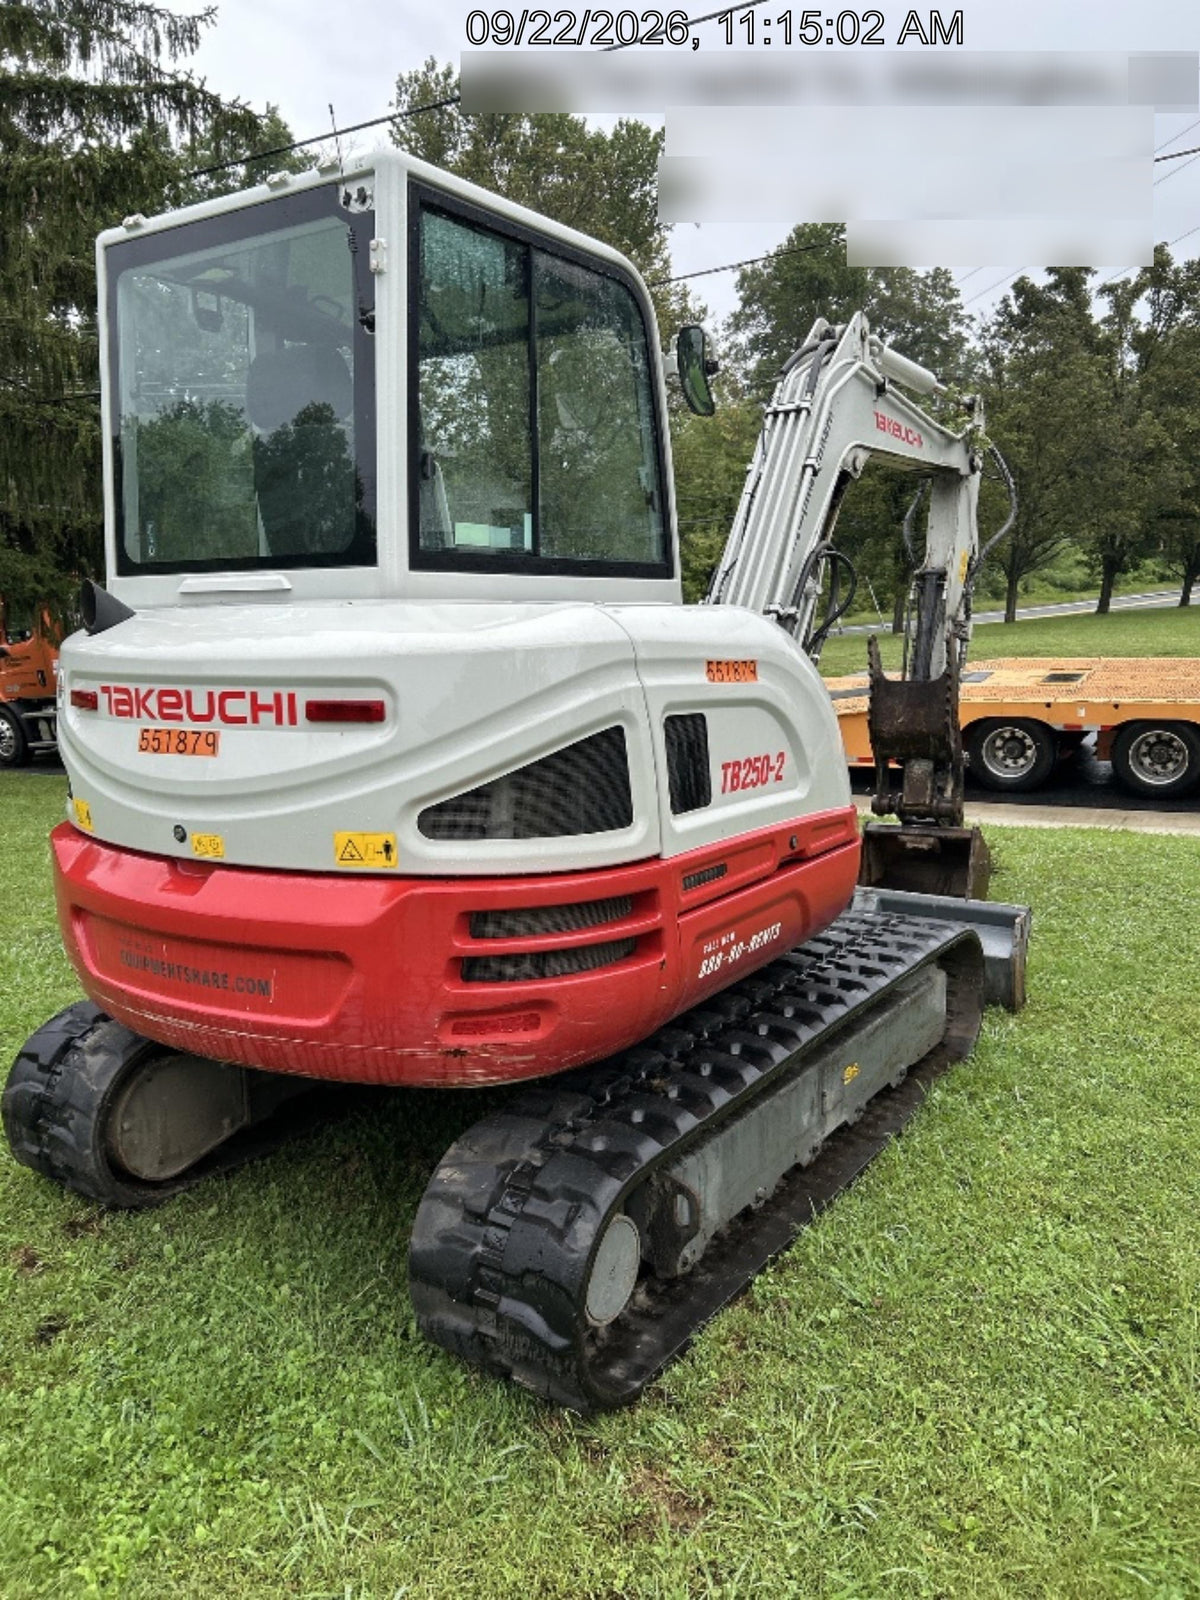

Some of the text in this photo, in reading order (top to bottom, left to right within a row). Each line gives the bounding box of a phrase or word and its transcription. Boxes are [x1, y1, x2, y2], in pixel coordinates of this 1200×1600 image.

[706, 660, 757, 682] 551879
[139, 729, 216, 755] 551879
[721, 751, 785, 794] TB250-2
